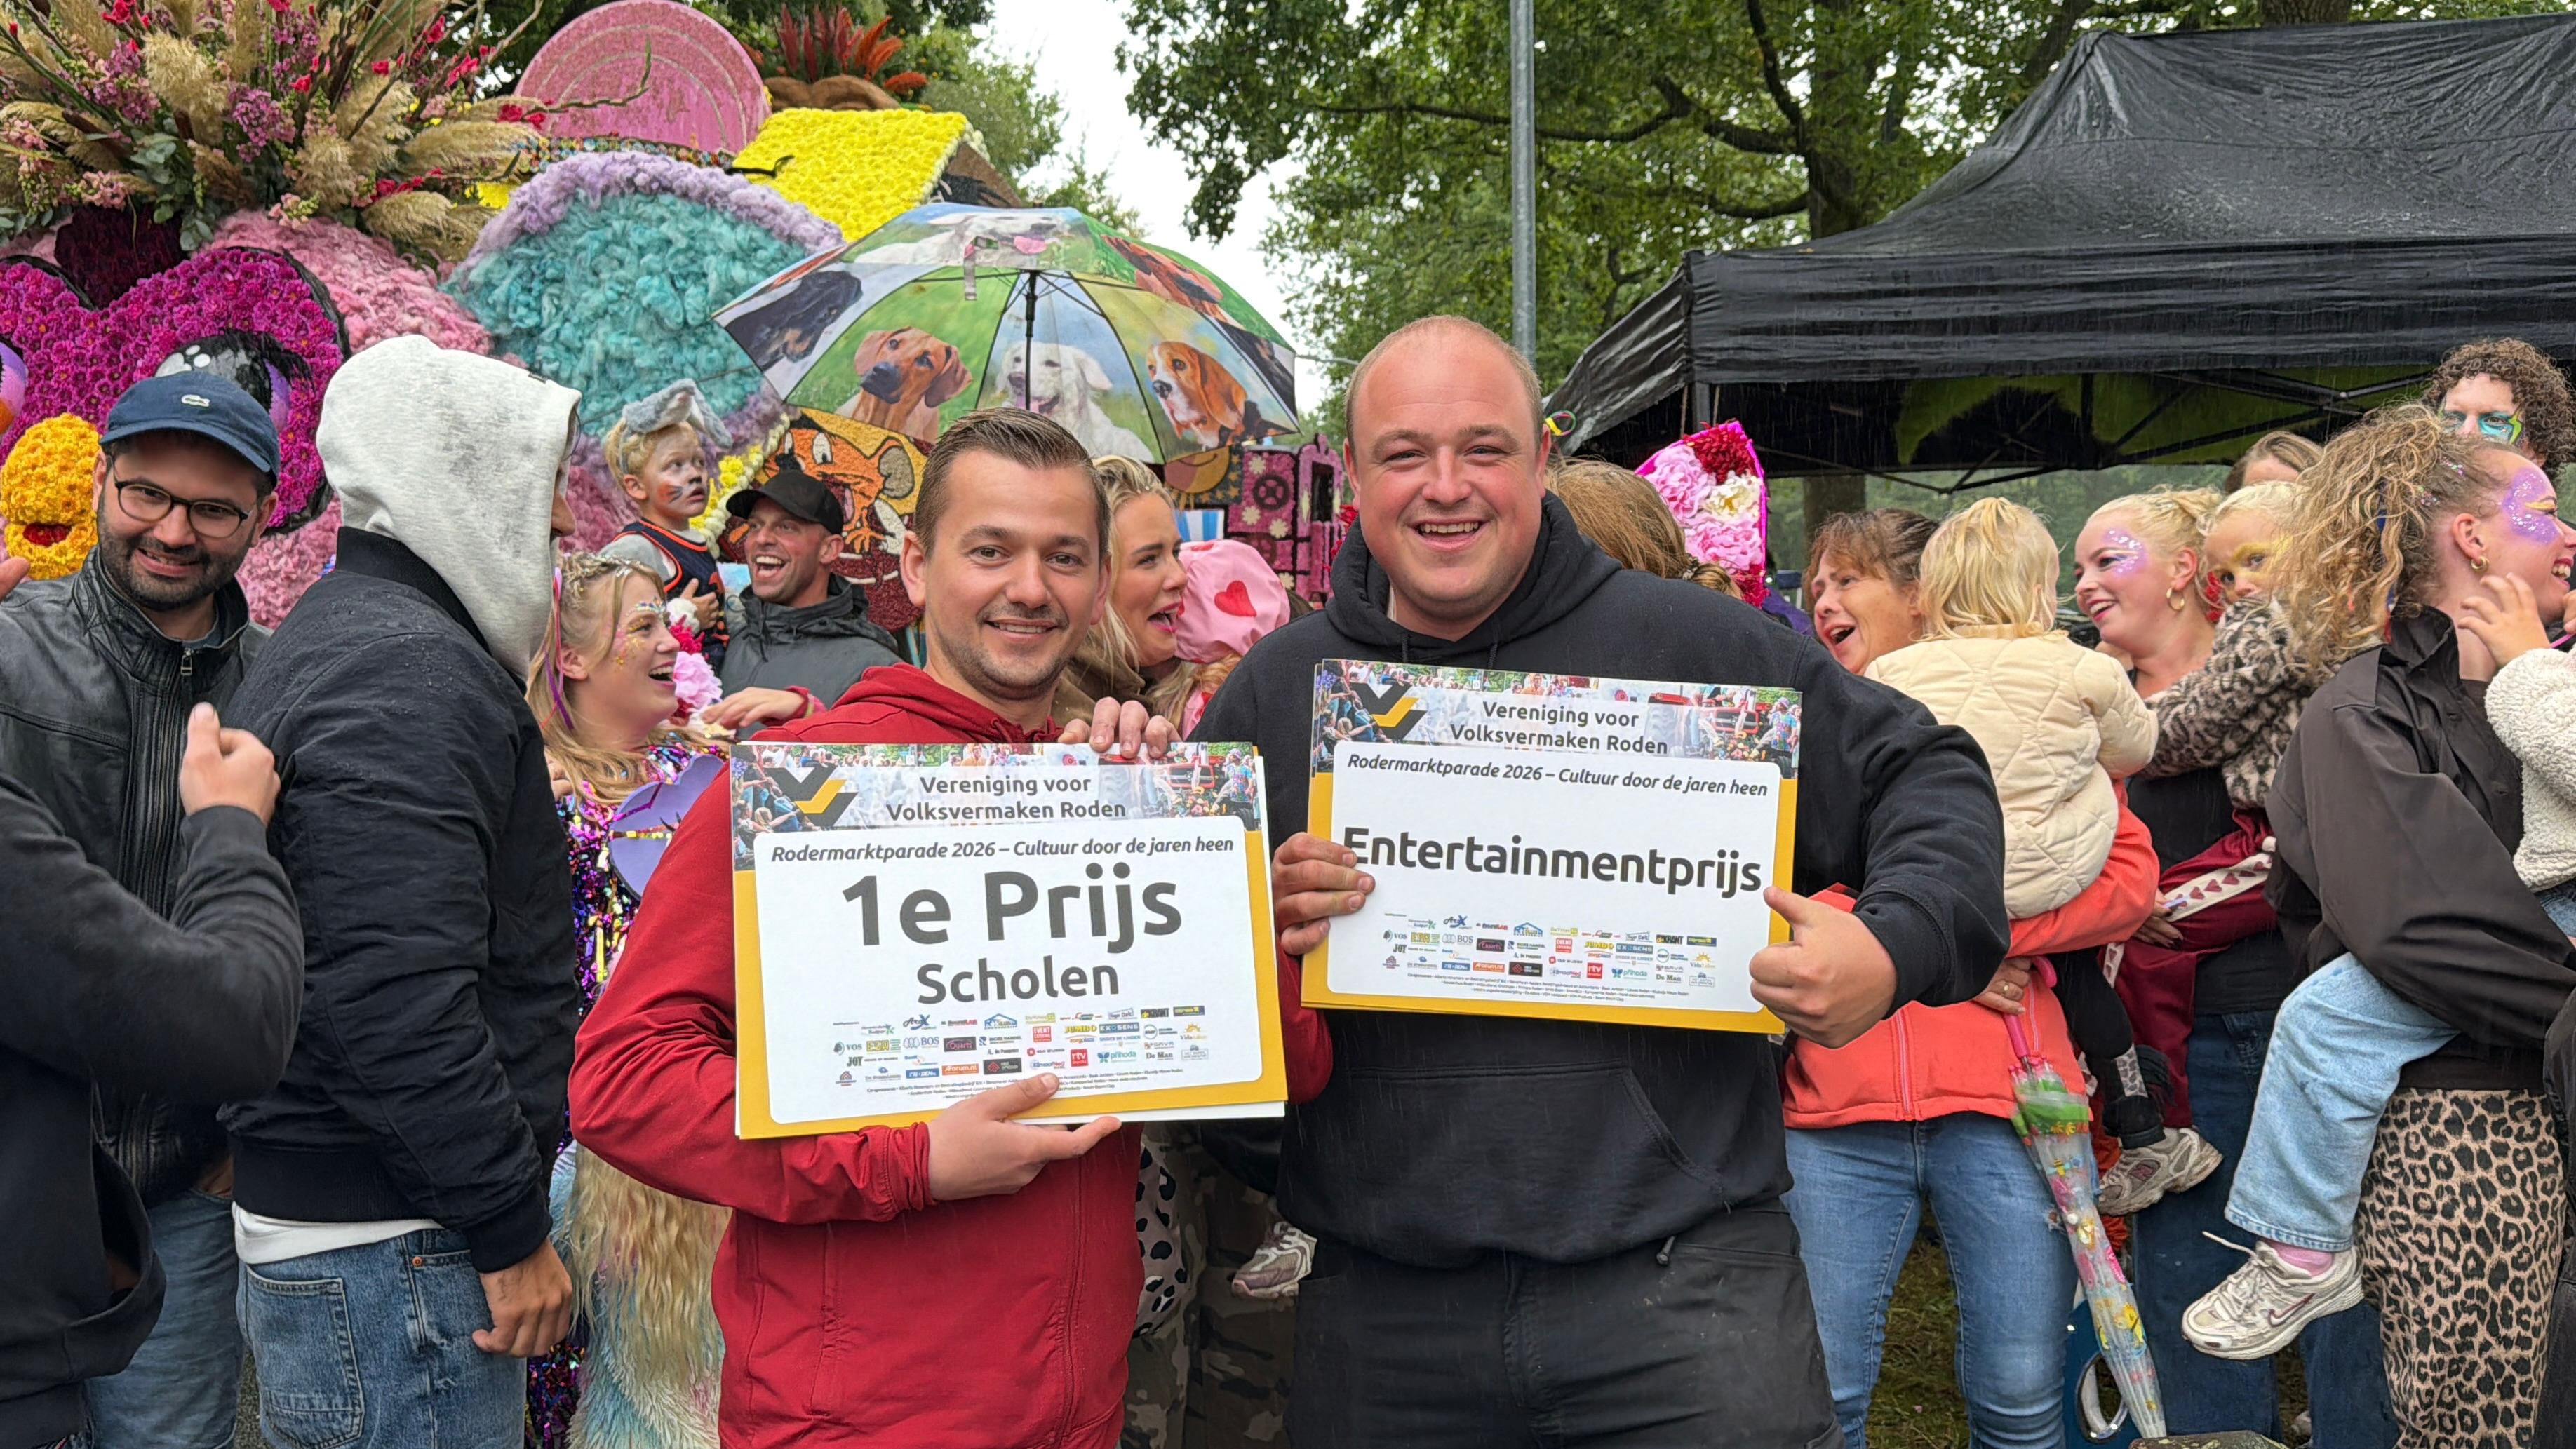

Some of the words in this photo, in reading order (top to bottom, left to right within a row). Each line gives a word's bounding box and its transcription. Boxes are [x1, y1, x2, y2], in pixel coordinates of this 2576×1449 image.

[1482, 701, 1588, 726] Vereniging
[1595, 713, 1639, 727] voor
[1450, 723, 1600, 749] Volksvermaken
[1607, 735, 1668, 755] Roden
[1348, 754, 1500, 778] Rodermarktparade
[1503, 764, 1543, 781] 2026
[1559, 768, 1618, 786] Cultuur
[1623, 771, 1660, 788] door
[1663, 774, 1682, 790] de
[1682, 776, 1726, 794] jaren
[1730, 779, 1768, 796] heen
[920, 775, 1038, 796] Vereniging
[1044, 779, 1091, 792] voor
[886, 801, 1054, 821] Volksvermaken
[1061, 800, 1126, 818] Roden
[772, 842, 948, 863] Rodermarktparade
[951, 842, 995, 857] 2026
[1014, 840, 1079, 856] Cultuur
[1082, 838, 1122, 854] door
[1125, 837, 1146, 854] de
[1146, 838, 1191, 856] jaren
[1195, 836, 1234, 851] heen
[1343, 828, 1761, 898] Entertainmentprijs
[843, 875, 951, 945] 1e
[984, 862, 1181, 954] Prijs
[1457, 934, 1474, 943] BOS
[1584, 941, 1615, 950] JUMBO
[1393, 943, 1407, 954] JOY
[1588, 965, 1602, 973] rtv
[917, 955, 1119, 1004] Scholen
[1064, 1024, 1097, 1034] JUMBO
[1100, 1023, 1139, 1032] EXOSENS
[921, 1037, 939, 1045] BOS
[847, 1056, 864, 1067] JOY
[1071, 1052, 1087, 1060] rtv
